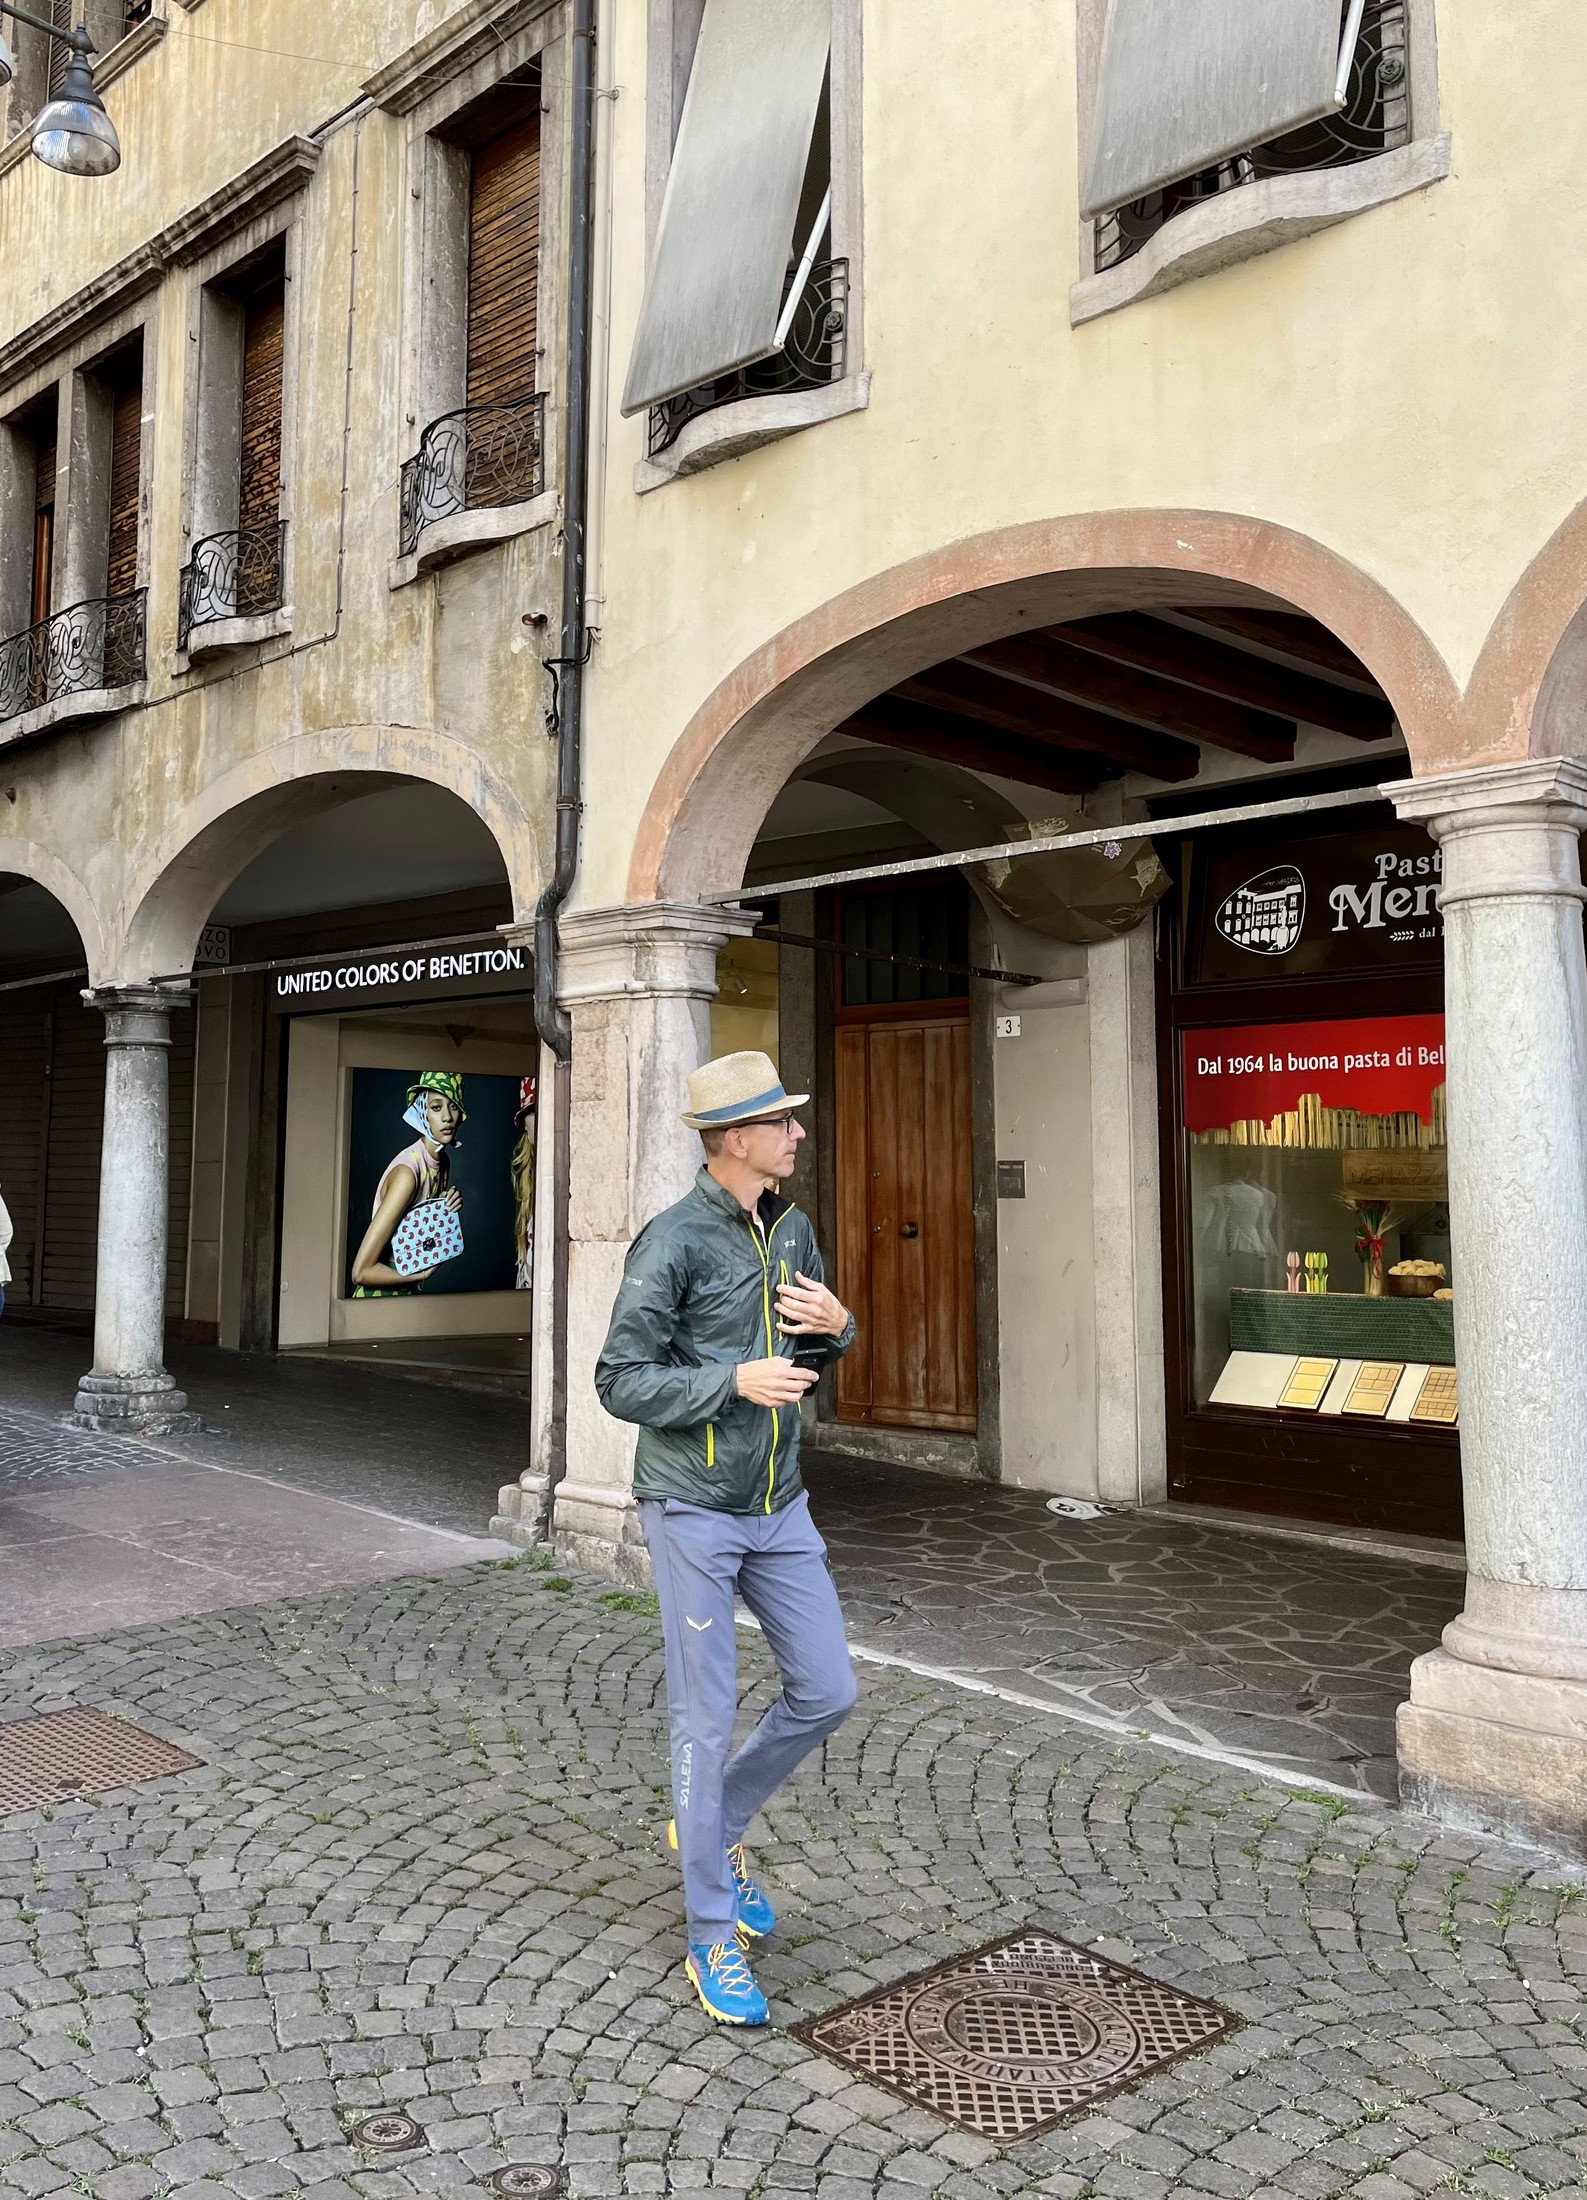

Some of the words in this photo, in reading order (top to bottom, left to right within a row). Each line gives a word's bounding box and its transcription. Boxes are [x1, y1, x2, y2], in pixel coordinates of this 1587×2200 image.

[1374, 849, 1442, 880] Past
[1329, 881, 1442, 932] Men
[200, 929, 227, 944] ZO
[1419, 927, 1436, 938] dal
[277, 970, 331, 996] UNITED
[335, 962, 399, 989] COLORS
[402, 959, 425, 982] OF
[430, 948, 525, 979] BENETTON.
[1005, 1019, 1012, 1034] 3
[1198, 1056, 1222, 1075] Dal
[1227, 1055, 1264, 1073] 1964
[1269, 1053, 1283, 1071] la
[1288, 1052, 1338, 1070] buona
[1344, 1050, 1390, 1073] pasta
[1395, 1047, 1412, 1066] di
[1418, 1044, 1445, 1065] Bel
[680, 1743, 693, 1810] SALEWA
